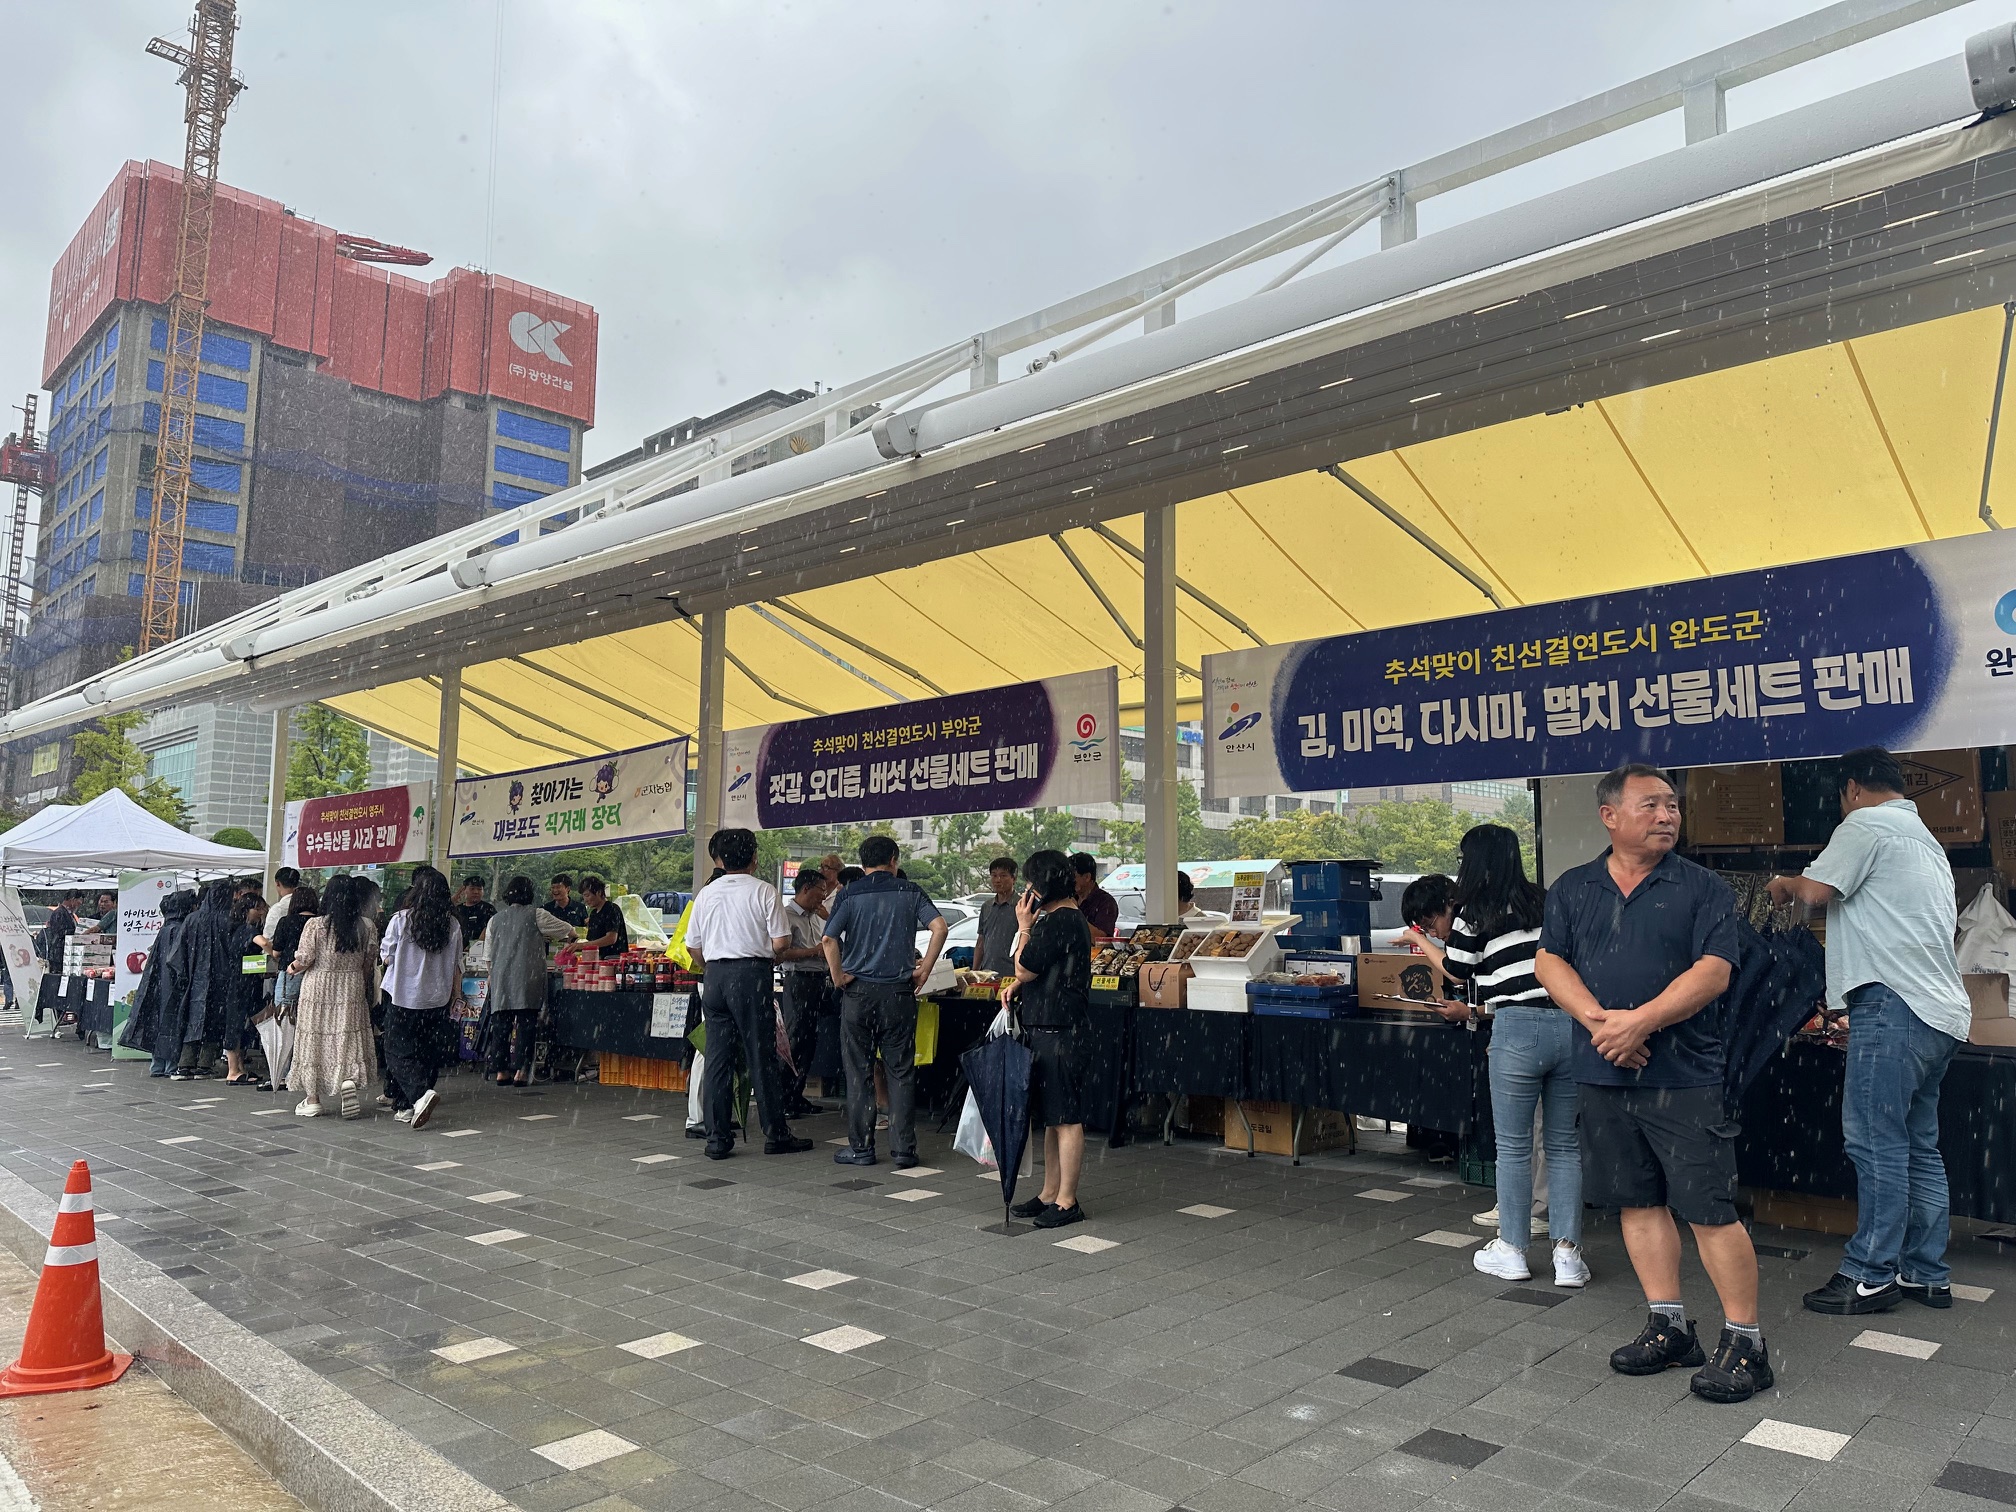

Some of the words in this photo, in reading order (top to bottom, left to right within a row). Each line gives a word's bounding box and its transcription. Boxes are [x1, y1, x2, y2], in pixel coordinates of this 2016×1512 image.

[1385, 648, 1480, 685] 추석맞이
[1491, 623, 1657, 673] 친선결연도시
[1669, 609, 1764, 650] 완도군
[1298, 713, 1336, 759] 김,
[1342, 704, 1414, 753] 미역,
[1419, 690, 1536, 746] 다시마,
[1543, 680, 1622, 737] 멸치
[1629, 660, 1806, 729] 선물세트
[1812, 646, 1914, 711] 판매
[812, 733, 858, 757] 추석맞이
[862, 722, 936, 750] 친선결연도시
[941, 716, 982, 739] 부안군
[1226, 743, 1255, 753] 안산시
[1073, 752, 1102, 763] 부안군
[641, 782, 672, 796] 군자농협
[769, 771, 806, 806] 젓갈,
[809, 764, 866, 802] 오디즙,
[869, 759, 907, 795] 버섯
[910, 749, 990, 791] 선물세트
[994, 742, 1039, 782] 판매
[530, 777, 584, 806] 찾아가는
[368, 803, 385, 818] 영주시
[493, 814, 541, 842] 대부포도
[544, 808, 587, 836] 직거래
[591, 802, 622, 831] 장터
[305, 829, 351, 855] 우수특산물
[353, 826, 374, 850] 사과
[376, 824, 398, 847] 판매
[123, 909, 158, 918] 아이러브
